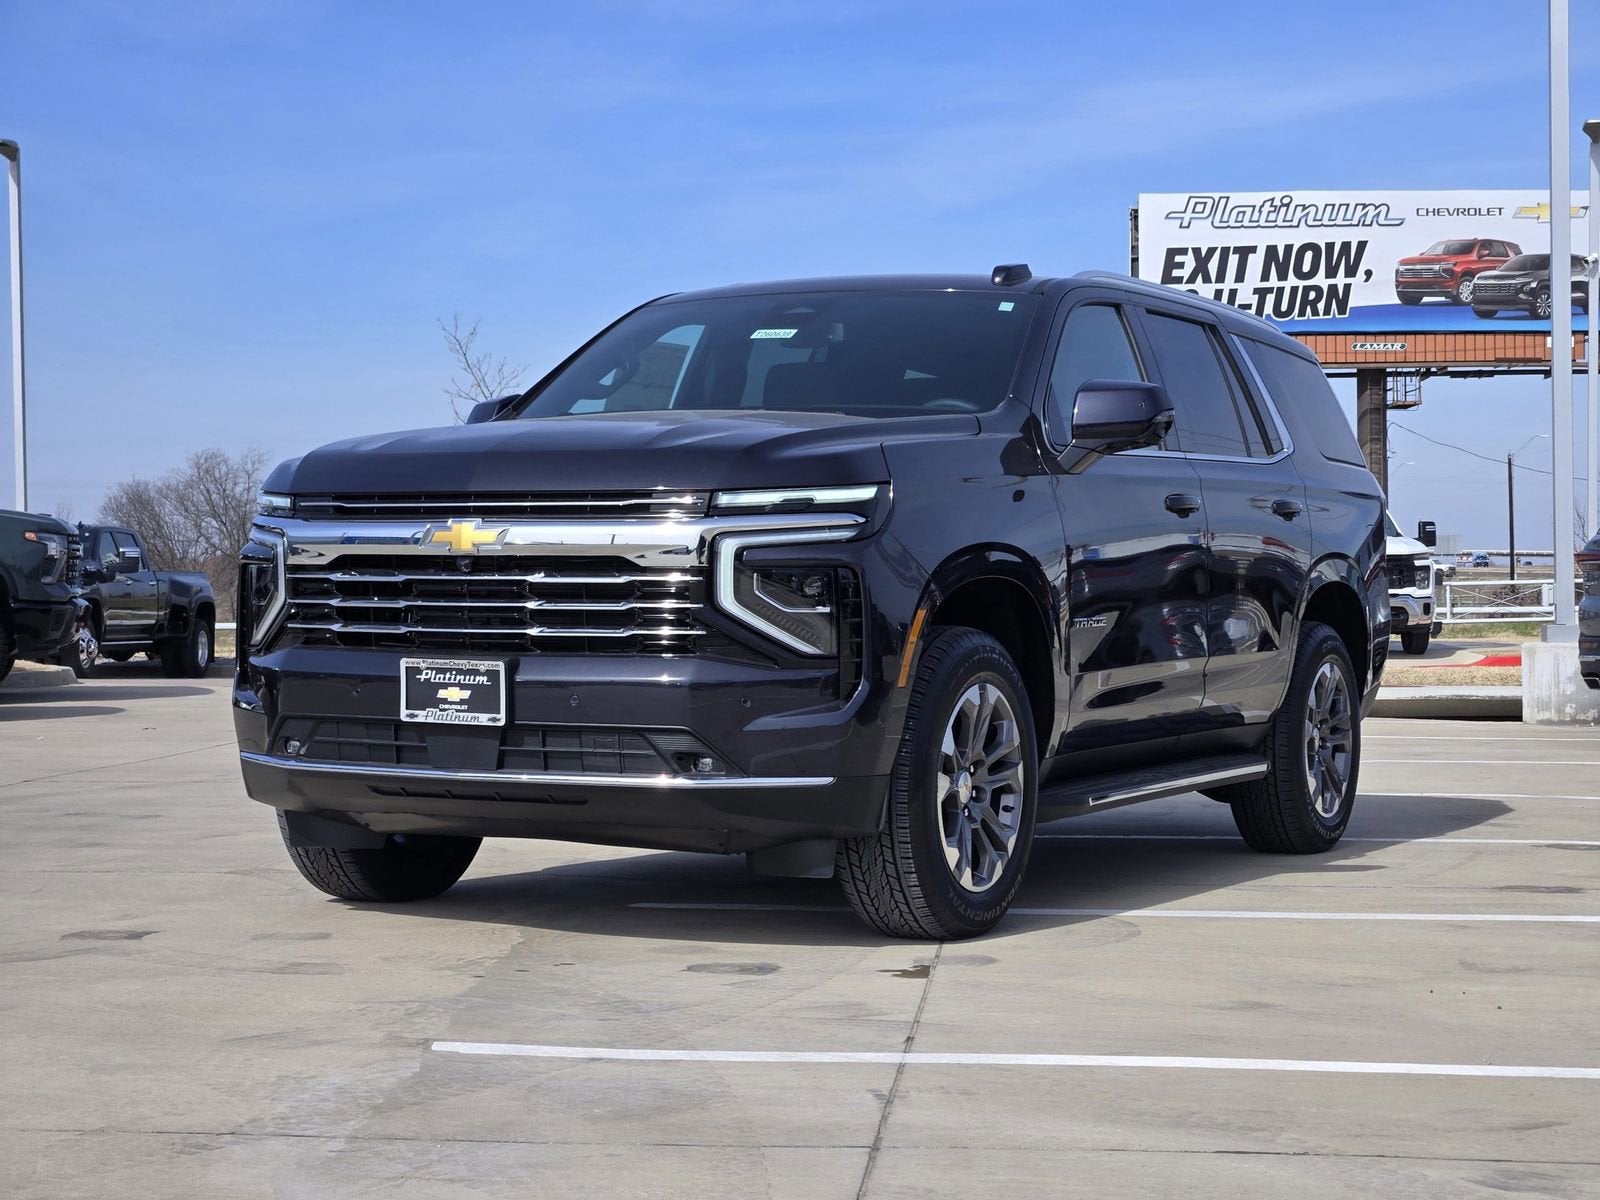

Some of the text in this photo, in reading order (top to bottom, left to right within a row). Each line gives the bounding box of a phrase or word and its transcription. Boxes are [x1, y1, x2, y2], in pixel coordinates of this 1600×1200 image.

[1164, 195, 1505, 229] Platinum CHEVROLET
[1160, 240, 1374, 285] EXIT NOW,
[1354, 343, 1403, 351] LAMAR
[1072, 616, 1107, 628] TAHOE
[416, 670, 492, 685] Platinum
[421, 708, 484, 723] Platinum
